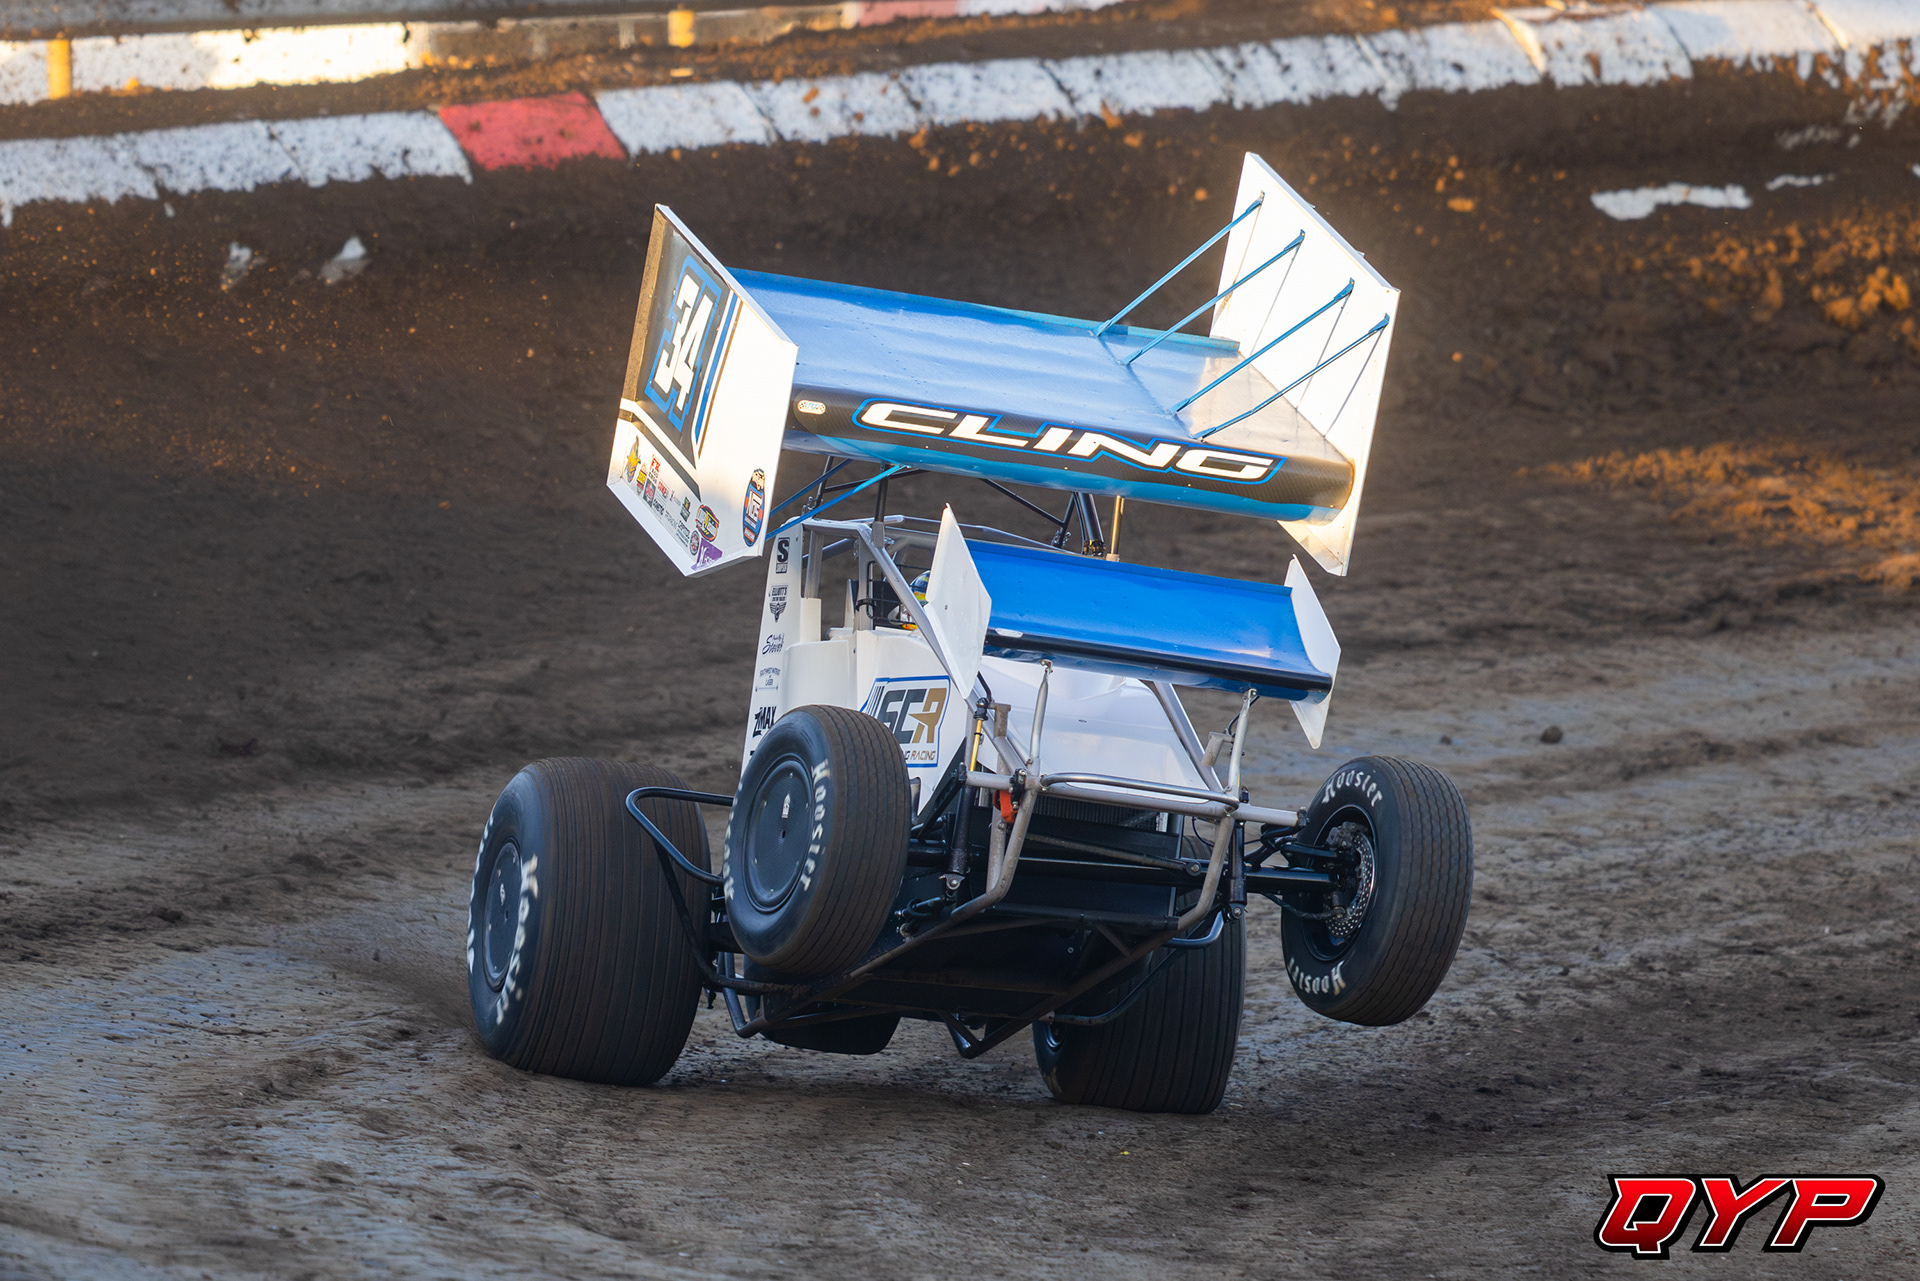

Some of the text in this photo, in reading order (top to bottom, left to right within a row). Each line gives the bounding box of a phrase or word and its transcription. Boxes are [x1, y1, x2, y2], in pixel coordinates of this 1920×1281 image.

[654, 273, 714, 411] 34
[860, 401, 1275, 480] CLING
[777, 539, 790, 562] S
[910, 750, 937, 761] RACING
[1321, 769, 1384, 807] Hoosier
[800, 758, 831, 892] Hoosier
